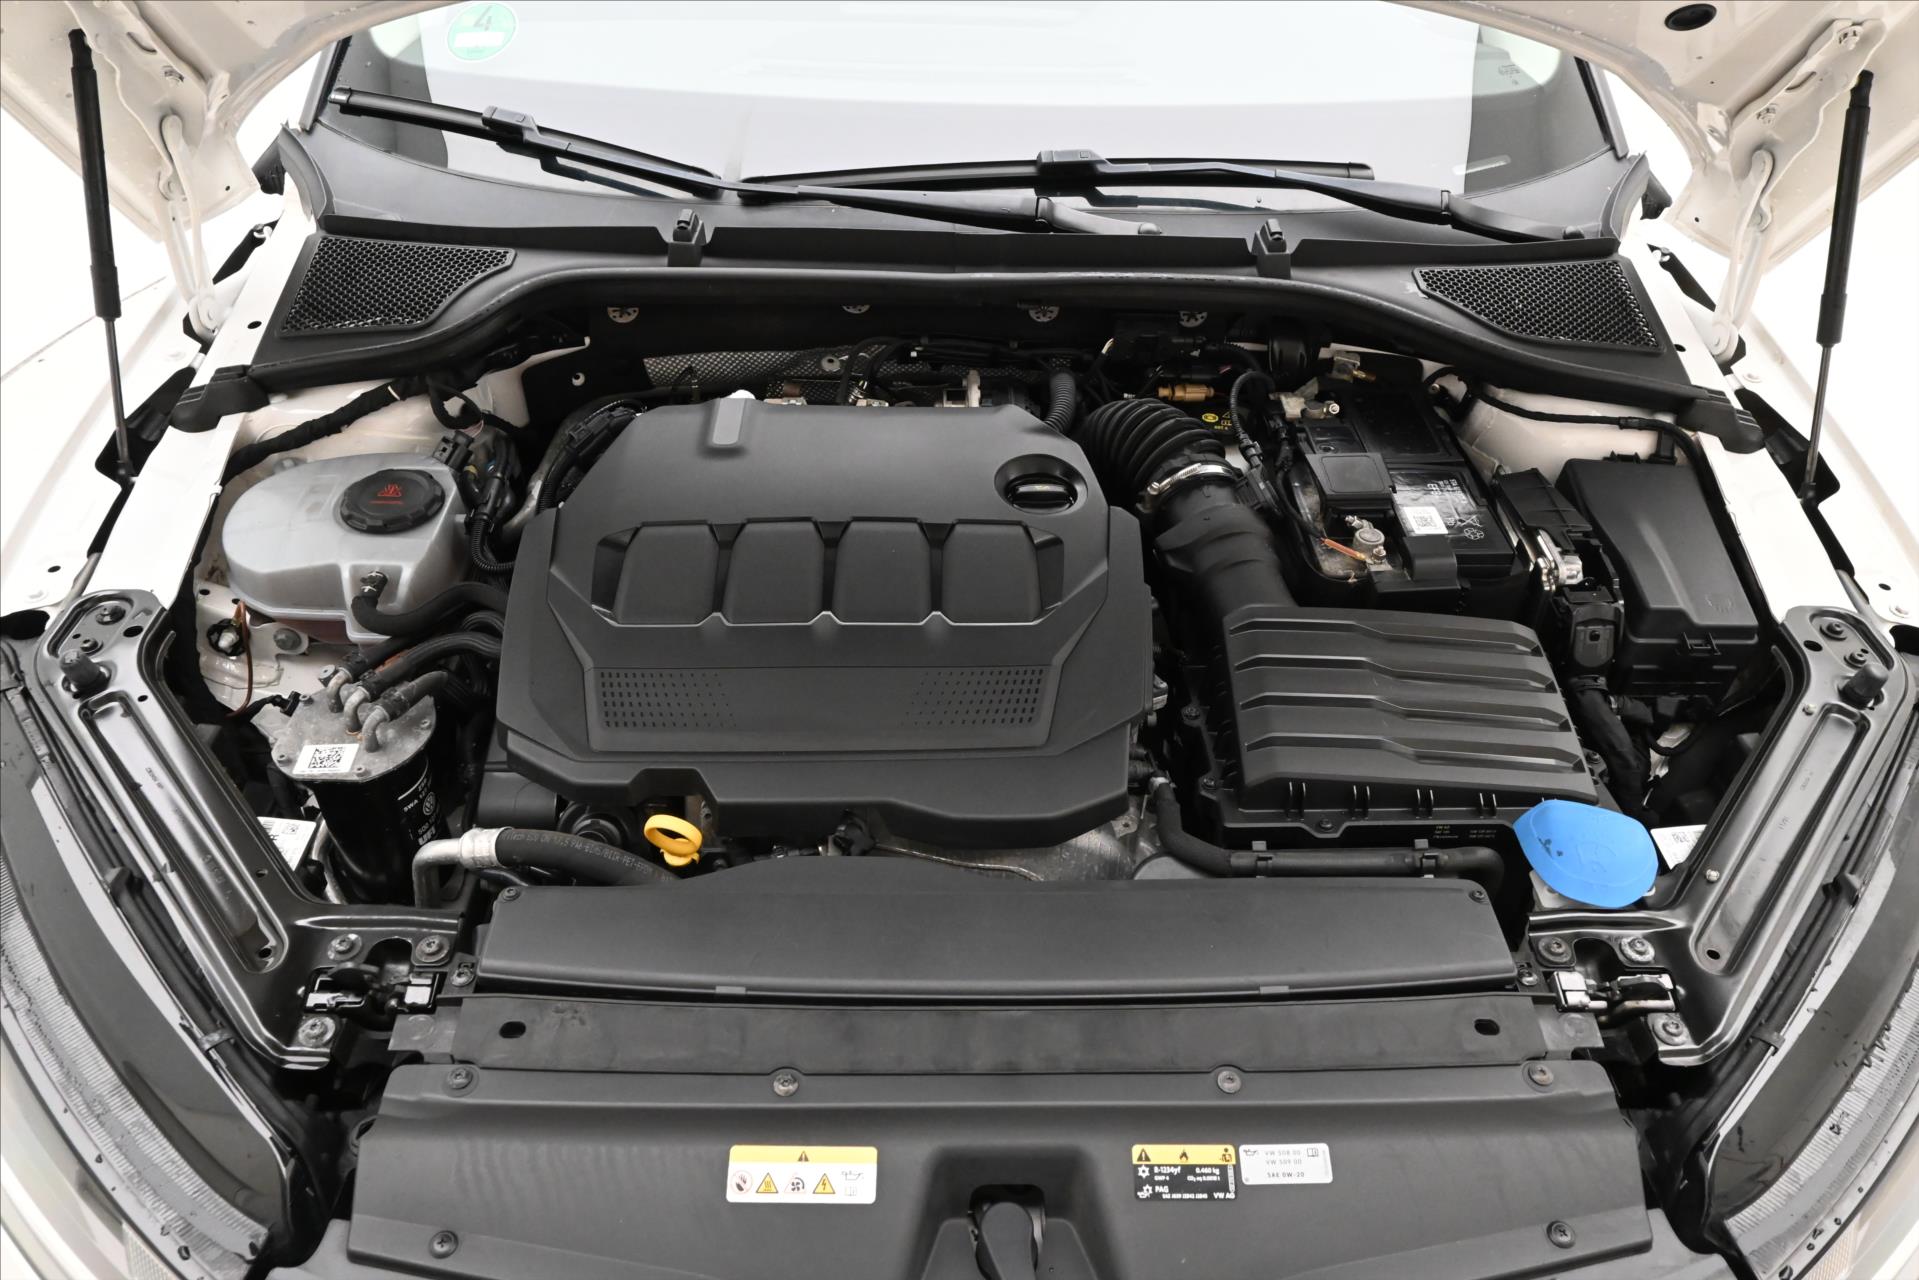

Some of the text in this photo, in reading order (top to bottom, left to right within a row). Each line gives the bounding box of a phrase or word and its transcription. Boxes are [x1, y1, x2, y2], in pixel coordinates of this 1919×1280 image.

[473, 5, 493, 31] 4
[1154, 1185, 1169, 1193] PAG
[1213, 1191, 1224, 1199] VW
[1225, 1191, 1235, 1199] AG
